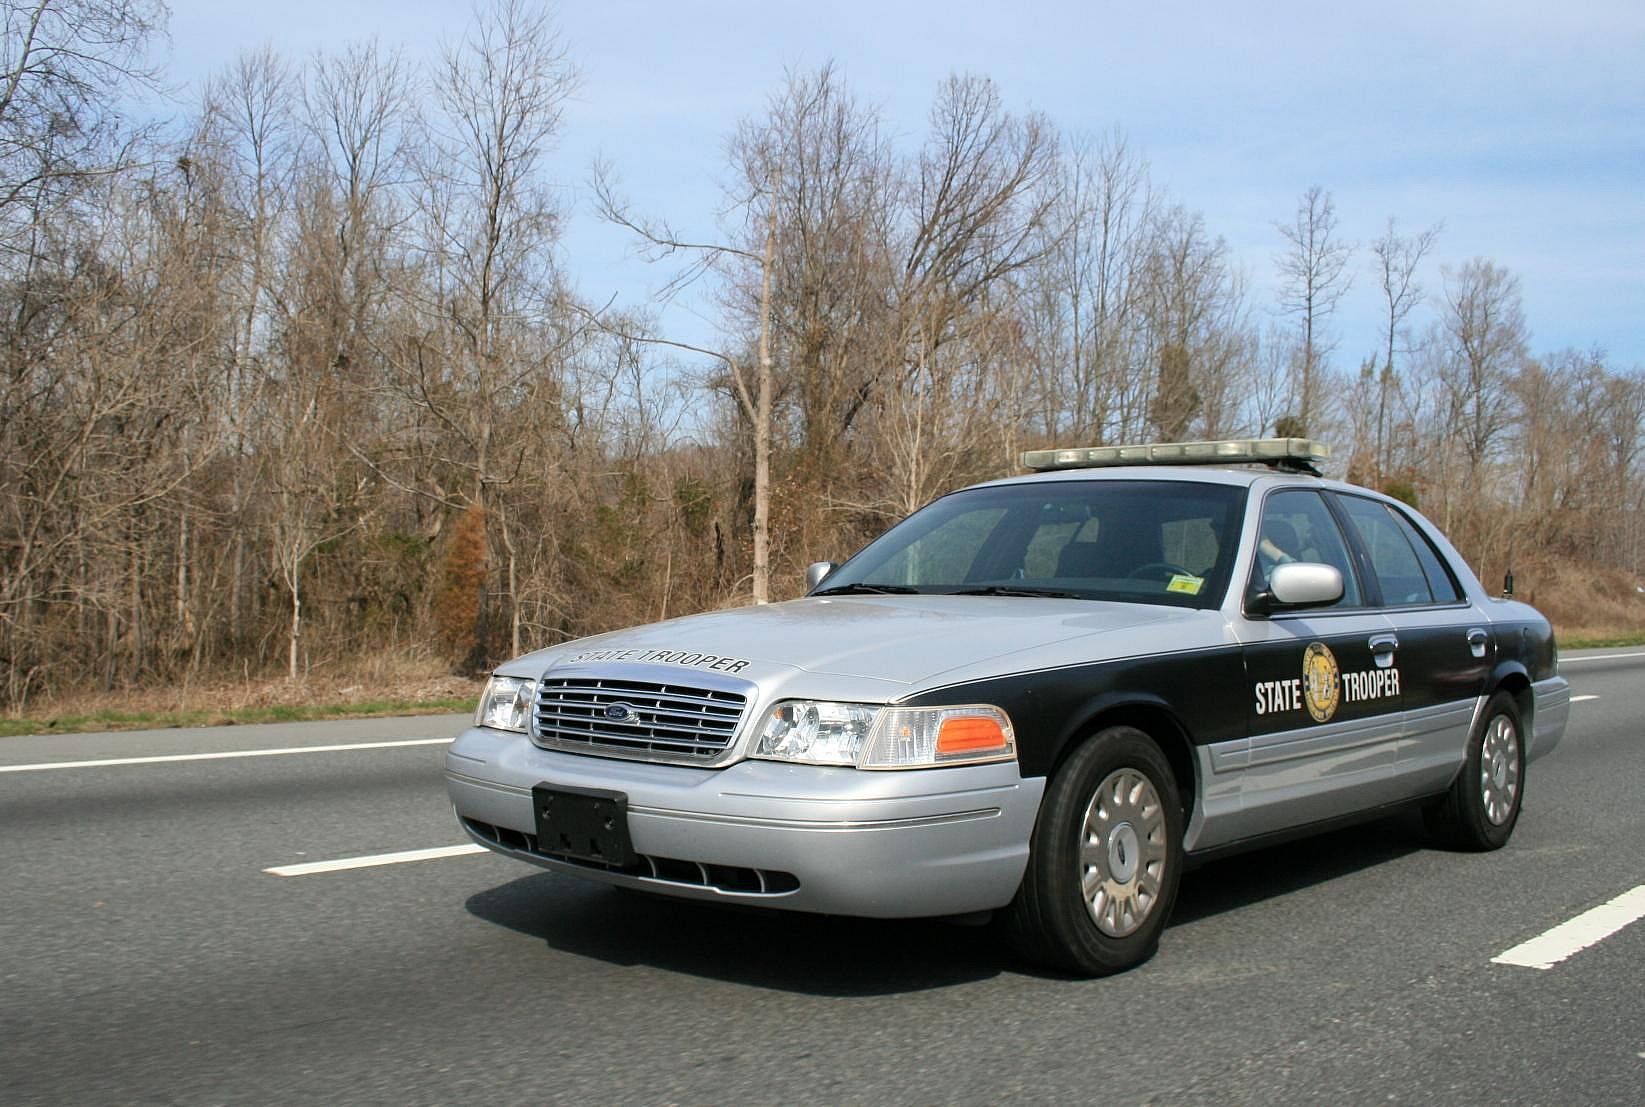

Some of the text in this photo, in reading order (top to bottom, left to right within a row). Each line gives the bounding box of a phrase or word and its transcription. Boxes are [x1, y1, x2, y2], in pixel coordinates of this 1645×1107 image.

[571, 650, 751, 674] STATE TROOPER
[1255, 679, 1301, 715] STATE
[1342, 668, 1400, 702] TROOPER
